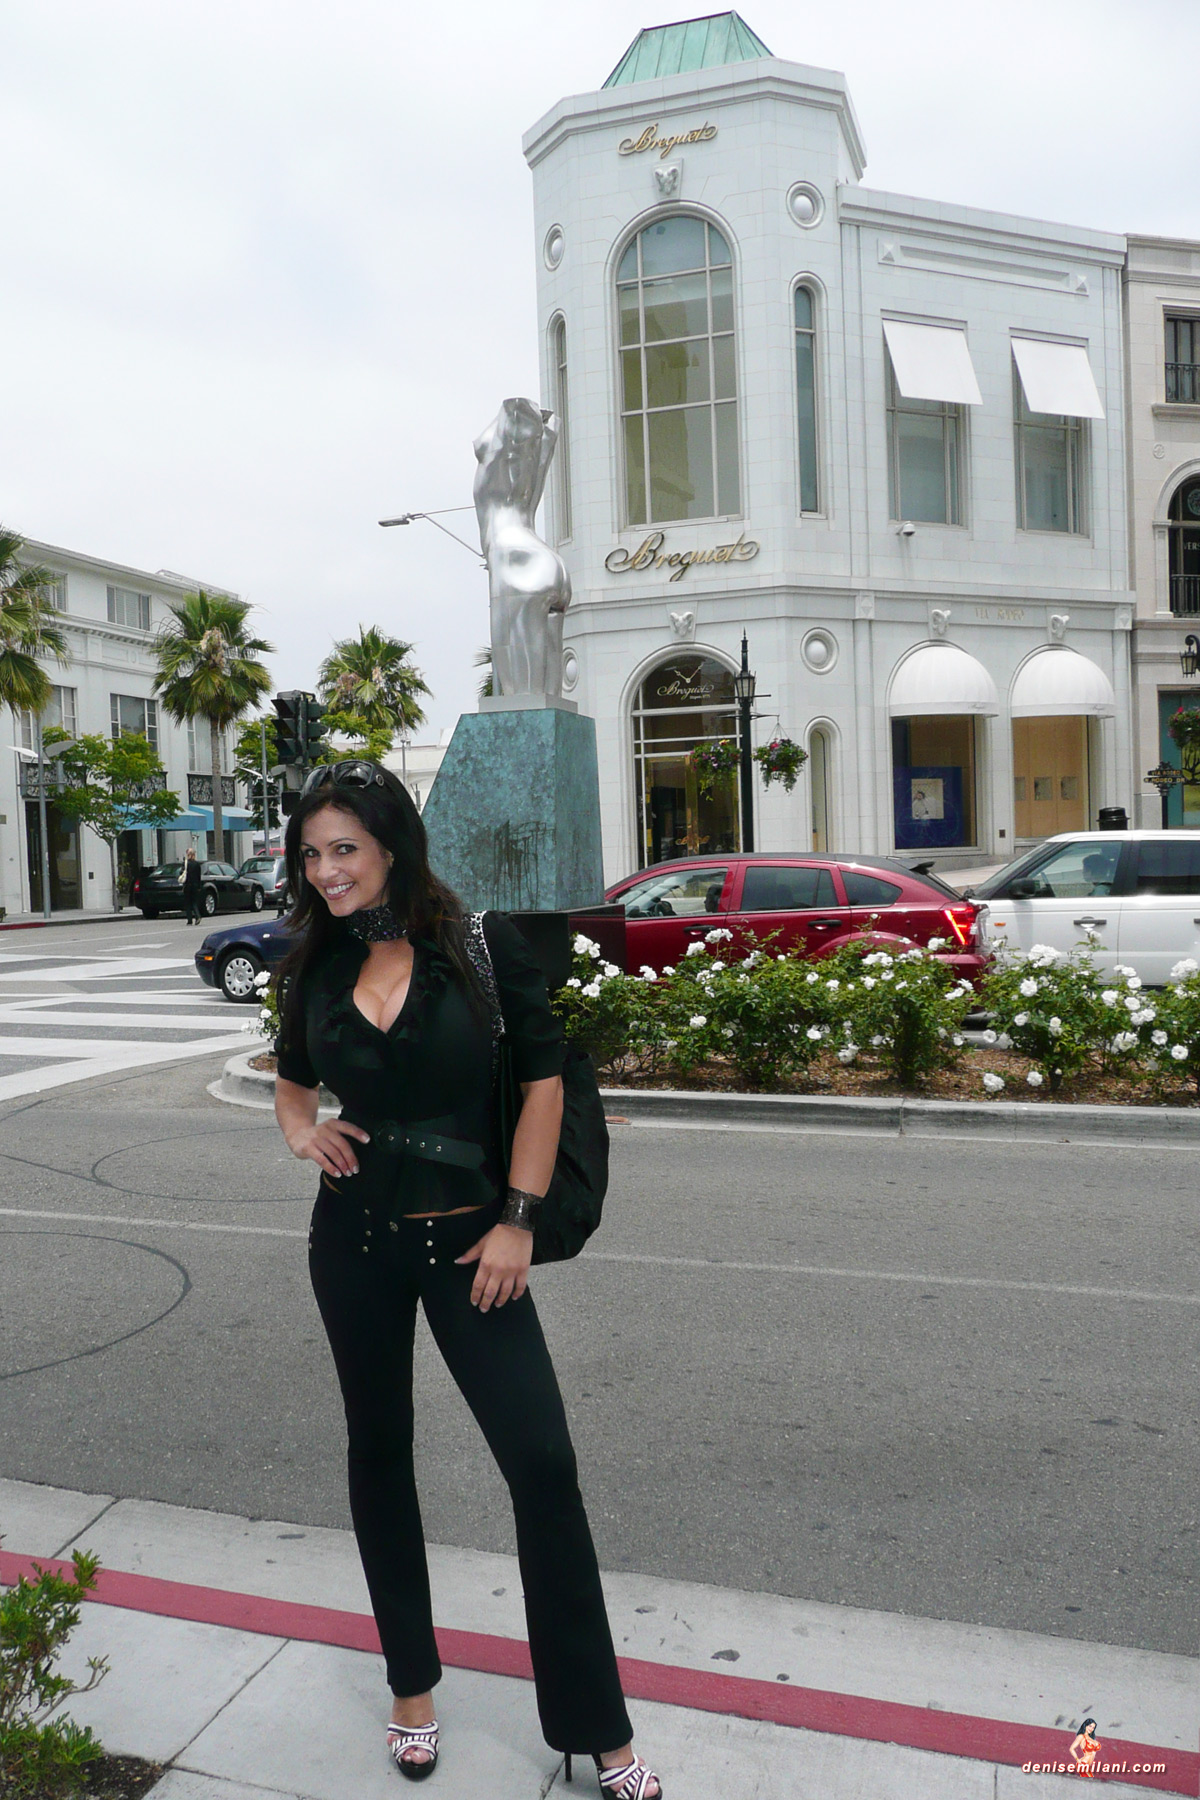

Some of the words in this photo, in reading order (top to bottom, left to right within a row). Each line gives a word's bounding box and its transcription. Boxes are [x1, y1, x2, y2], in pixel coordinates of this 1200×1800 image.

[617, 121, 719, 160] Breguet
[604, 530, 760, 582] Breguet
[656, 680, 715, 700] Breguet
